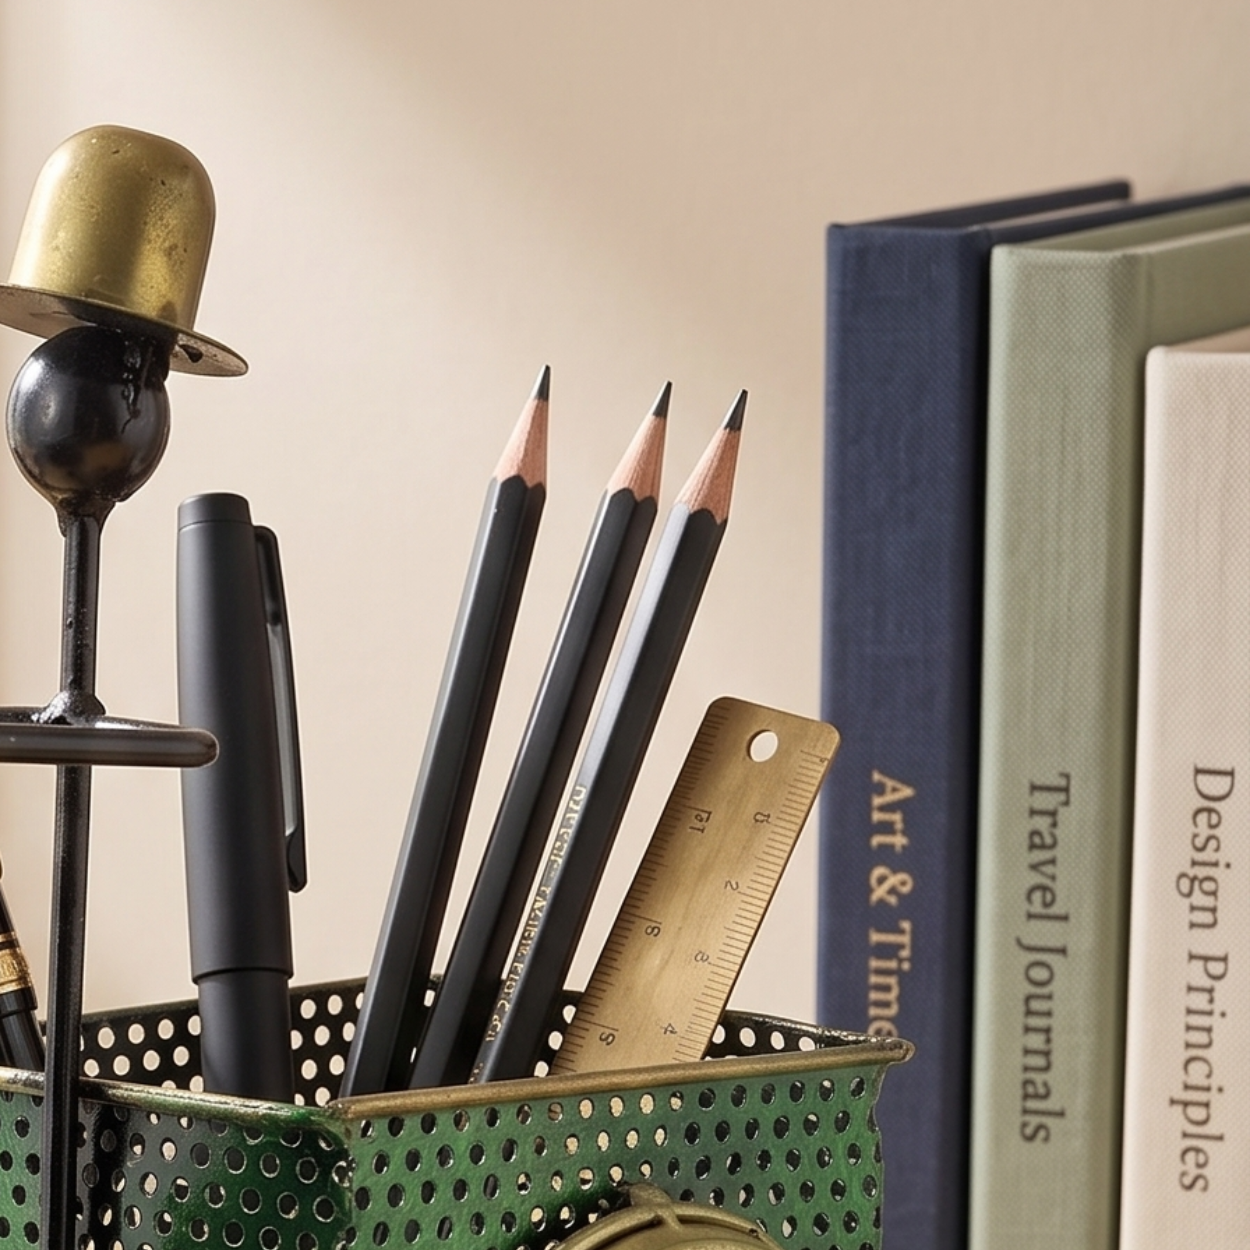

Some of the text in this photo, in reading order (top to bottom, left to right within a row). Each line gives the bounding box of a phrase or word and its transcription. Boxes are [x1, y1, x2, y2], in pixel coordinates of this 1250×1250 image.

[868, 768, 917, 854] Art
[868, 864, 914, 907] &
[1015, 771, 1071, 1145] Travel Journals
[1169, 763, 1236, 1195] Design Principles
